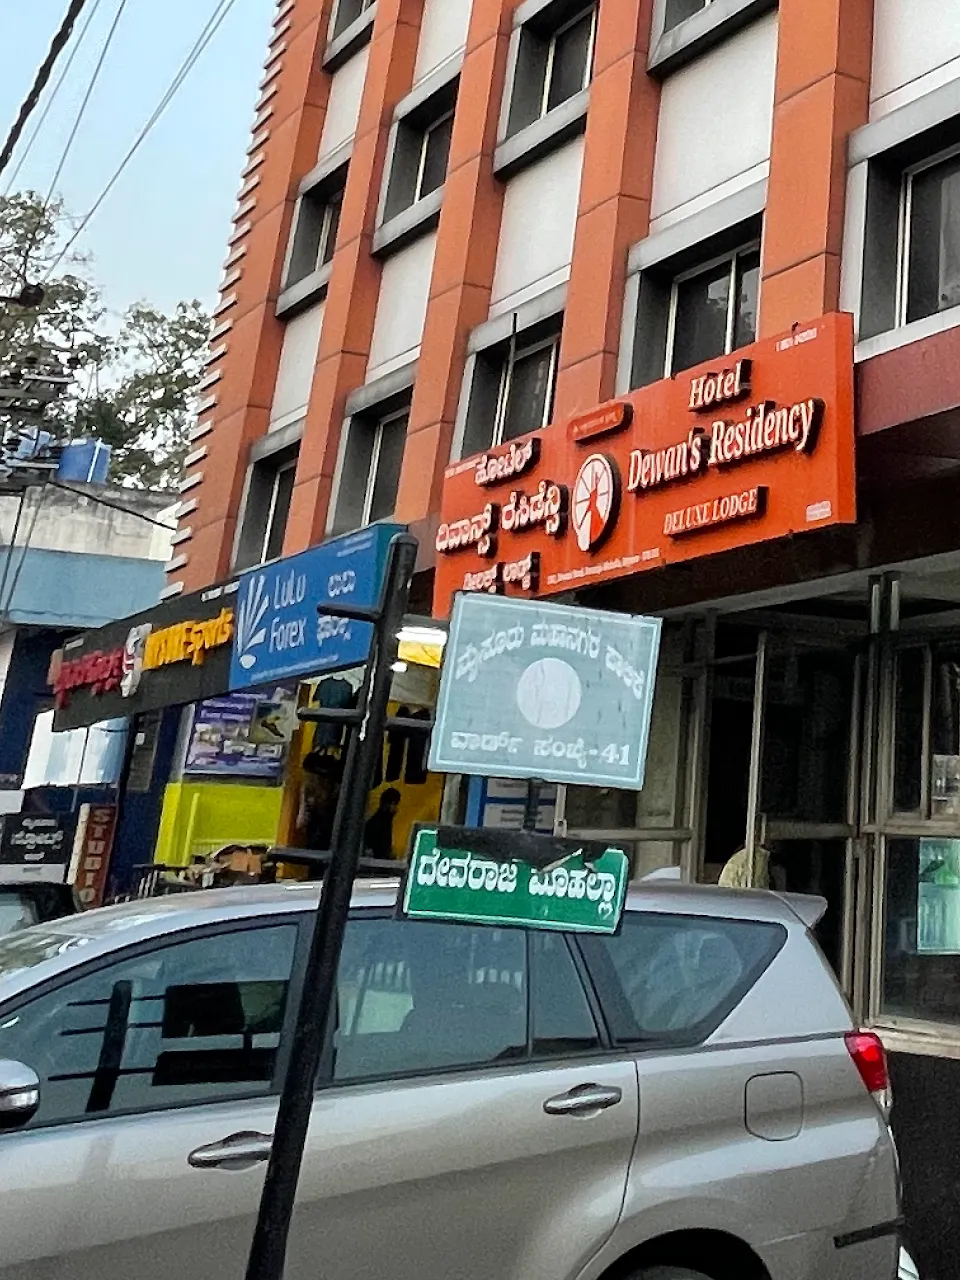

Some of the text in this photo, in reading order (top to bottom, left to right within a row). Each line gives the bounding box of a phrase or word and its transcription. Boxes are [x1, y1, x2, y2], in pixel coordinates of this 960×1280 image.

[689, 361, 741, 409] Hotel
[475, 441, 533, 485] ಹೋಟೆಲ್
[627, 400, 815, 490] Dewan's Residency
[663, 488, 758, 534] DELUXE LODGE
[416, 846, 519, 893] ದೇವರಾಜ
